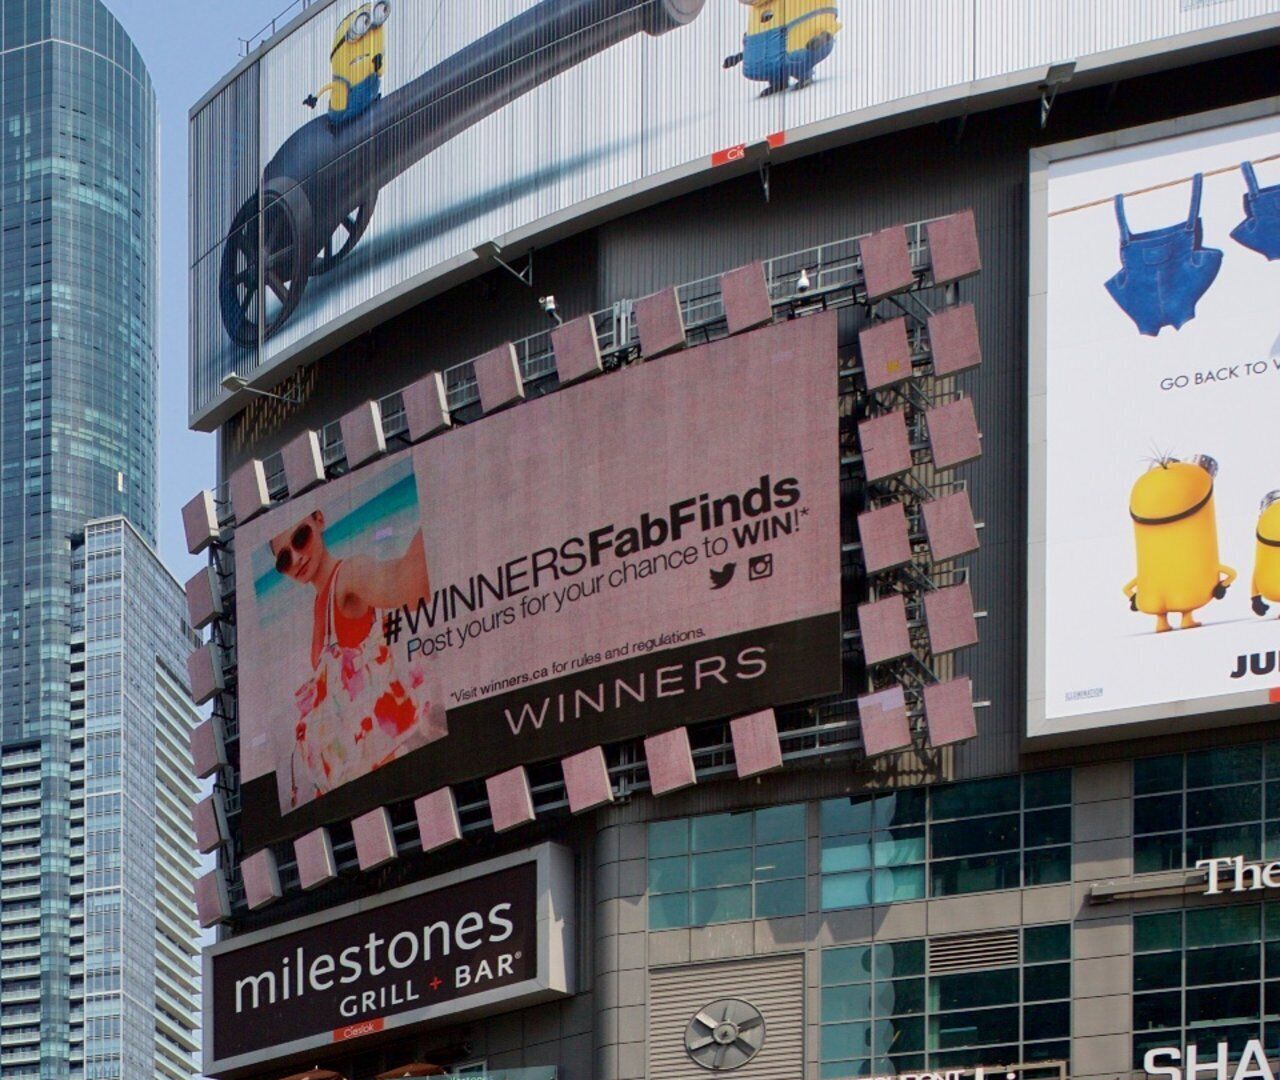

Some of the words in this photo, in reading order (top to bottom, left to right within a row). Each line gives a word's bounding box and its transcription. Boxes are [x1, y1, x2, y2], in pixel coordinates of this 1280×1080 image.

[1160, 374, 1189, 391] GO
[1195, 364, 1240, 386] BACK
[1244, 360, 1268, 376] TO
[384, 474, 802, 647] #WINNERSFabFinds
[406, 632, 454, 663] Post
[456, 604, 517, 649] yours
[520, 592, 549, 620] for
[551, 574, 605, 612] your
[608, 546, 700, 590] chance
[702, 532, 730, 559] to
[480, 667, 549, 695] winners.ca
[552, 660, 569, 675] for
[571, 652, 601, 670] rules
[604, 643, 630, 659] and
[632, 626, 707, 654] regulations.
[504, 646, 768, 737] WINNERS
[1196, 856, 1280, 896] The
[235, 902, 514, 1013] milestones
[340, 980, 420, 1018] GRILL
